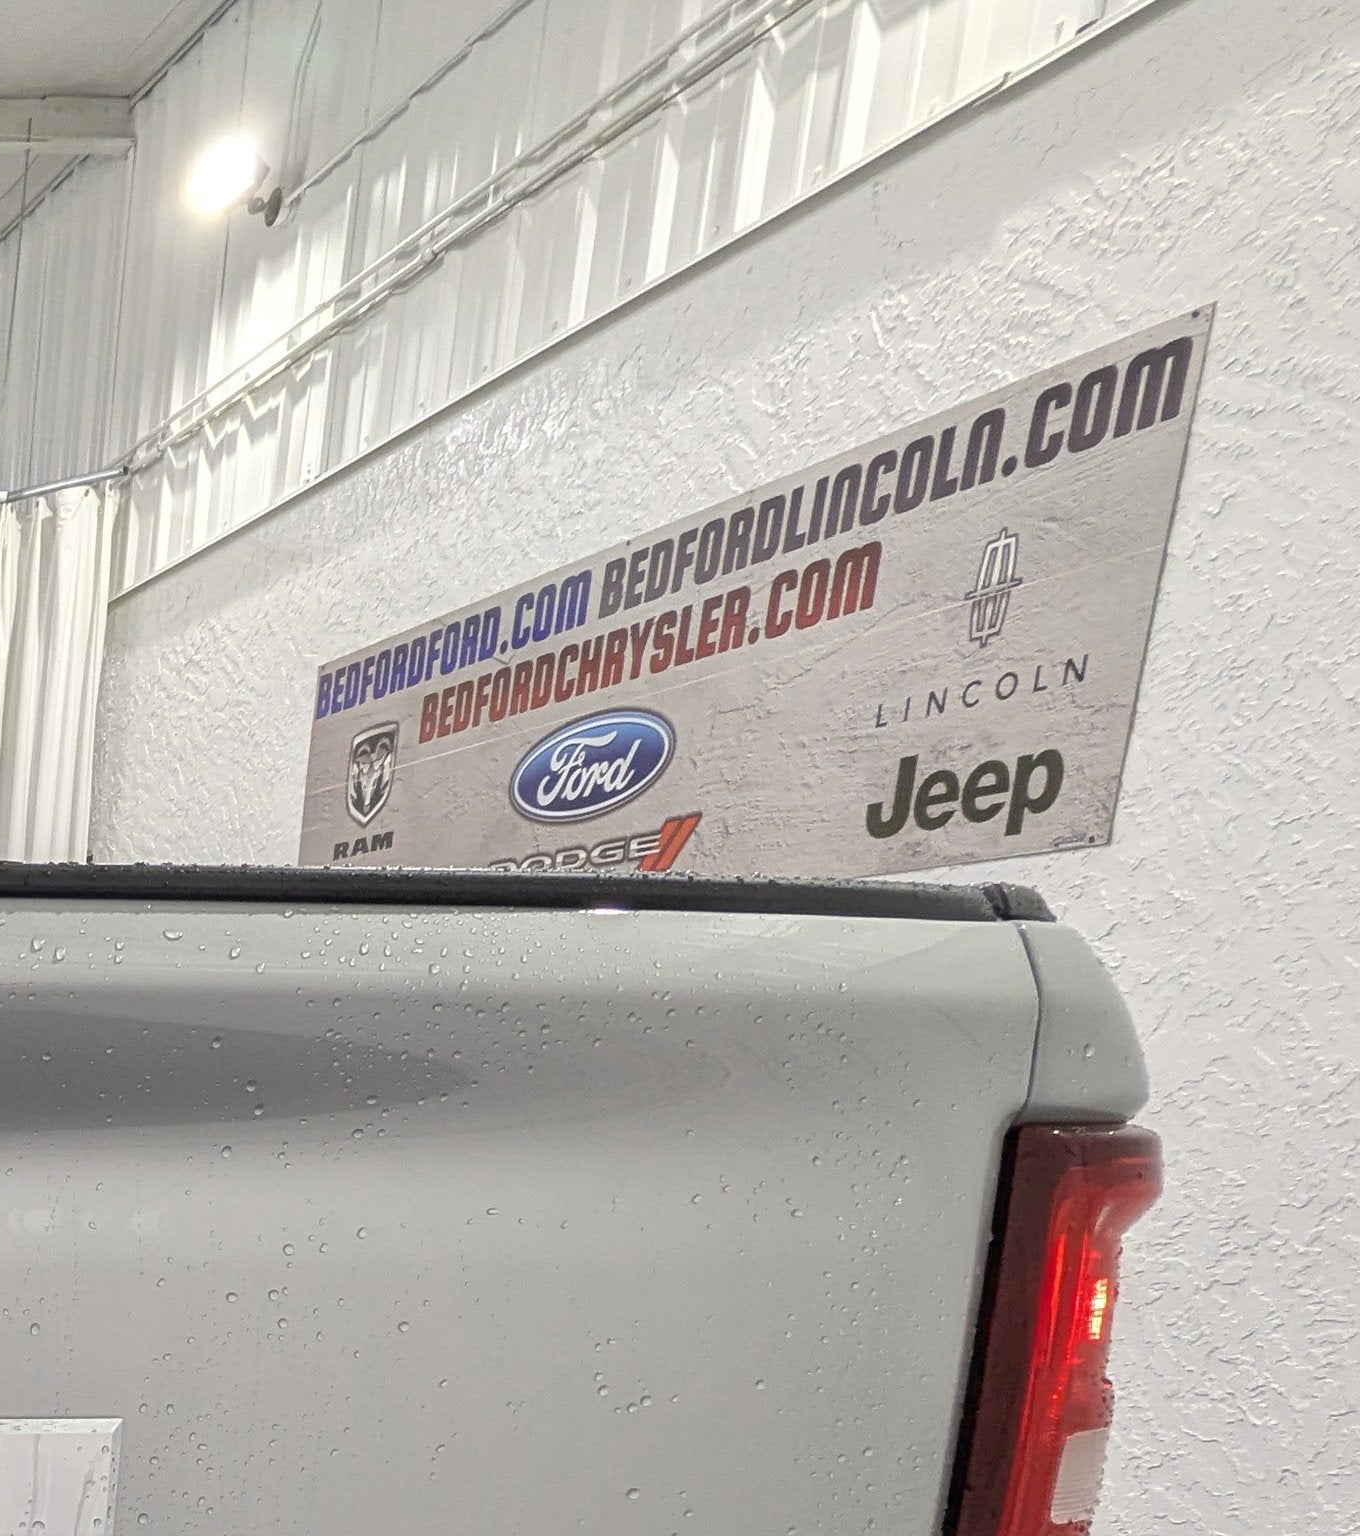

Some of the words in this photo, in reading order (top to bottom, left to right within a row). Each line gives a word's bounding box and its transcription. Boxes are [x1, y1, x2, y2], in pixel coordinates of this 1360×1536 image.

[316, 570, 591, 719] BEDFORDFORD.COM
[599, 336, 1191, 619] BEDFORDLINCOLN.COM
[419, 540, 882, 744] BEDFORDCHRYSLER.COM
[875, 654, 1089, 728] LINCOLN
[540, 730, 636, 804] Ford
[867, 748, 1065, 839] Jeep
[333, 831, 394, 861] RAM
